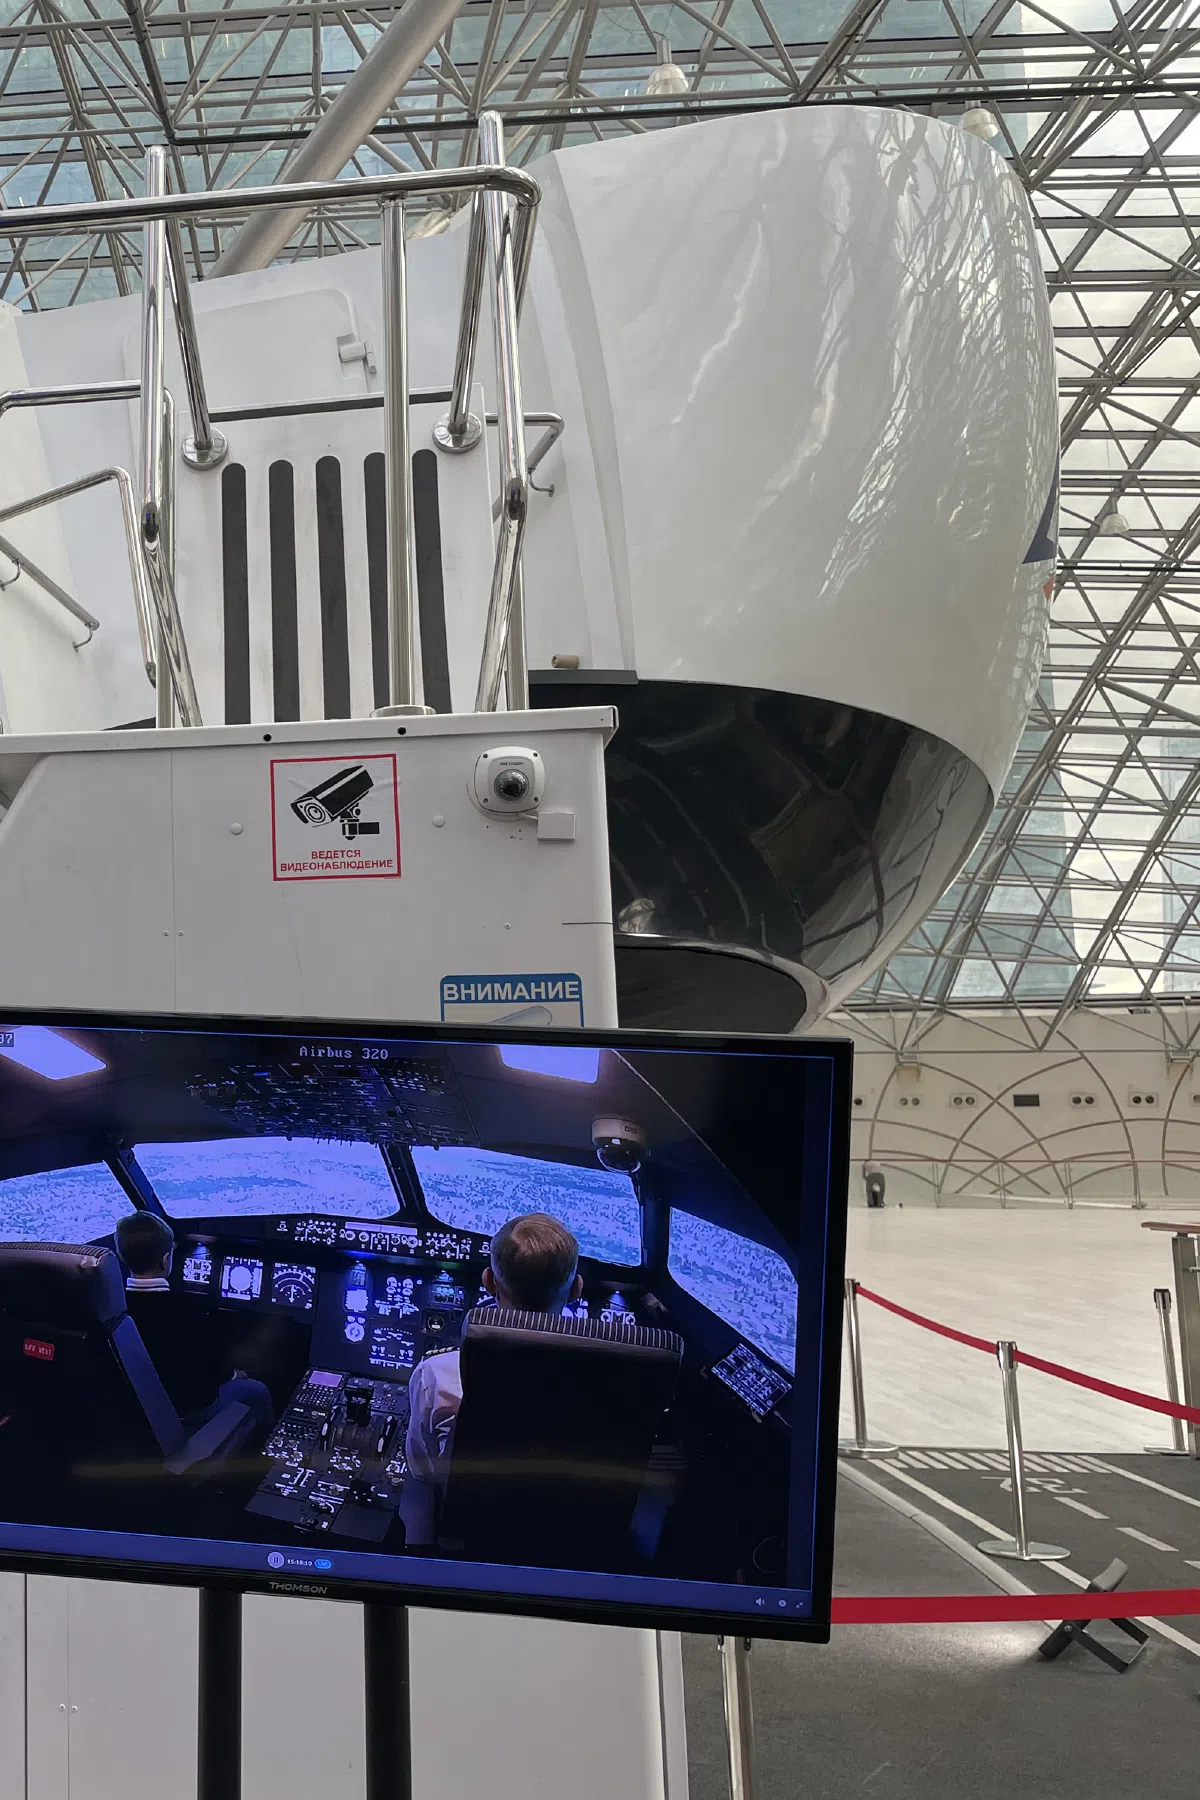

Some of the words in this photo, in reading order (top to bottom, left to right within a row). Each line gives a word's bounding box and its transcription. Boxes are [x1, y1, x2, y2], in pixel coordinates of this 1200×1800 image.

[311, 849, 361, 860] ВЕДЕТСЯ
[280, 859, 394, 873] ВИДЕОНАБЛЮДЕНИЕ
[443, 981, 580, 1001] ВНИМАНИЕ
[299, 1045, 353, 1059] Airbus
[361, 1047, 389, 1060] 320
[269, 1581, 328, 1594] THOMSON
